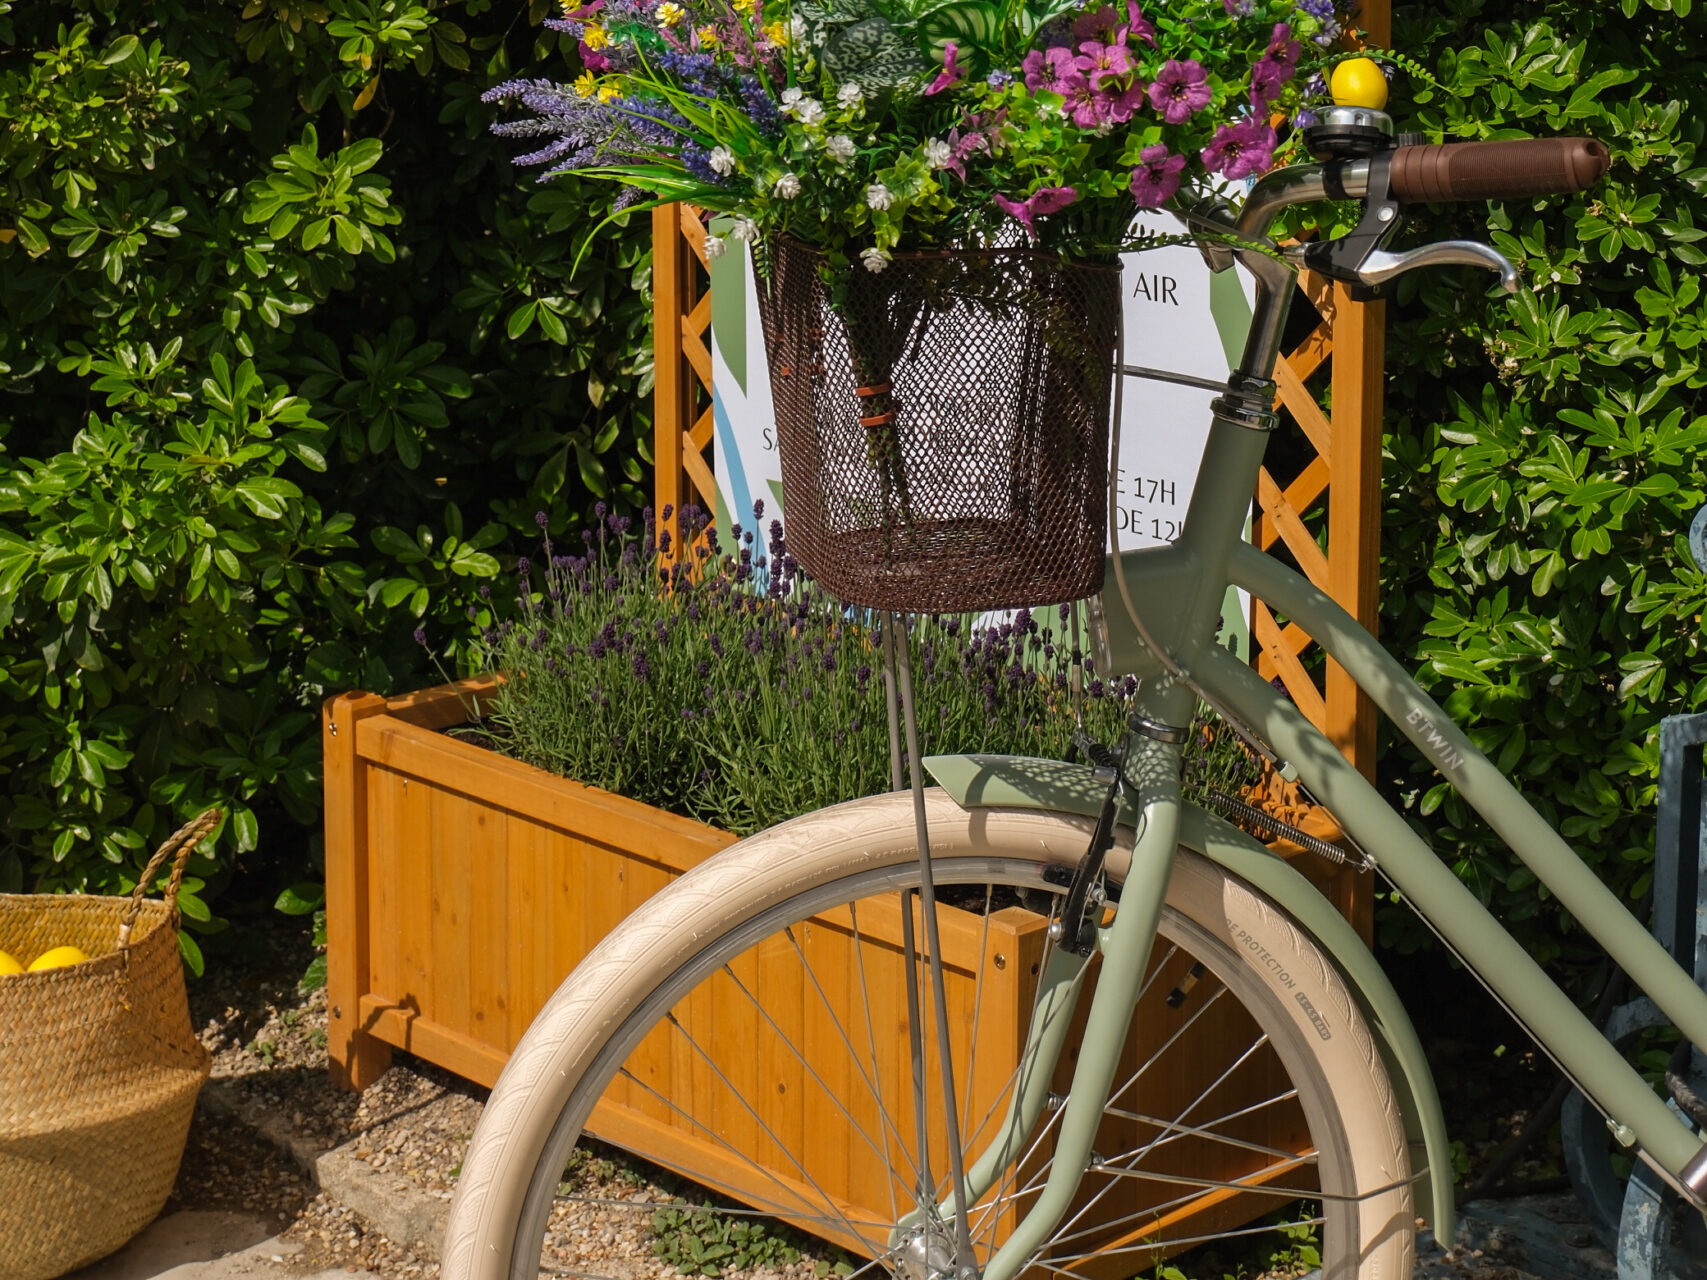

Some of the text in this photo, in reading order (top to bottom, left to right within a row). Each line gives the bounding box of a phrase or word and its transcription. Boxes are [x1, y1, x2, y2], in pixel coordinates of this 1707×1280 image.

[1132, 272, 1179, 306] AIR
[1133, 477, 1175, 506] 17H
[1116, 505, 1143, 535] DE
[1236, 930, 1297, 990] PROTECTION
